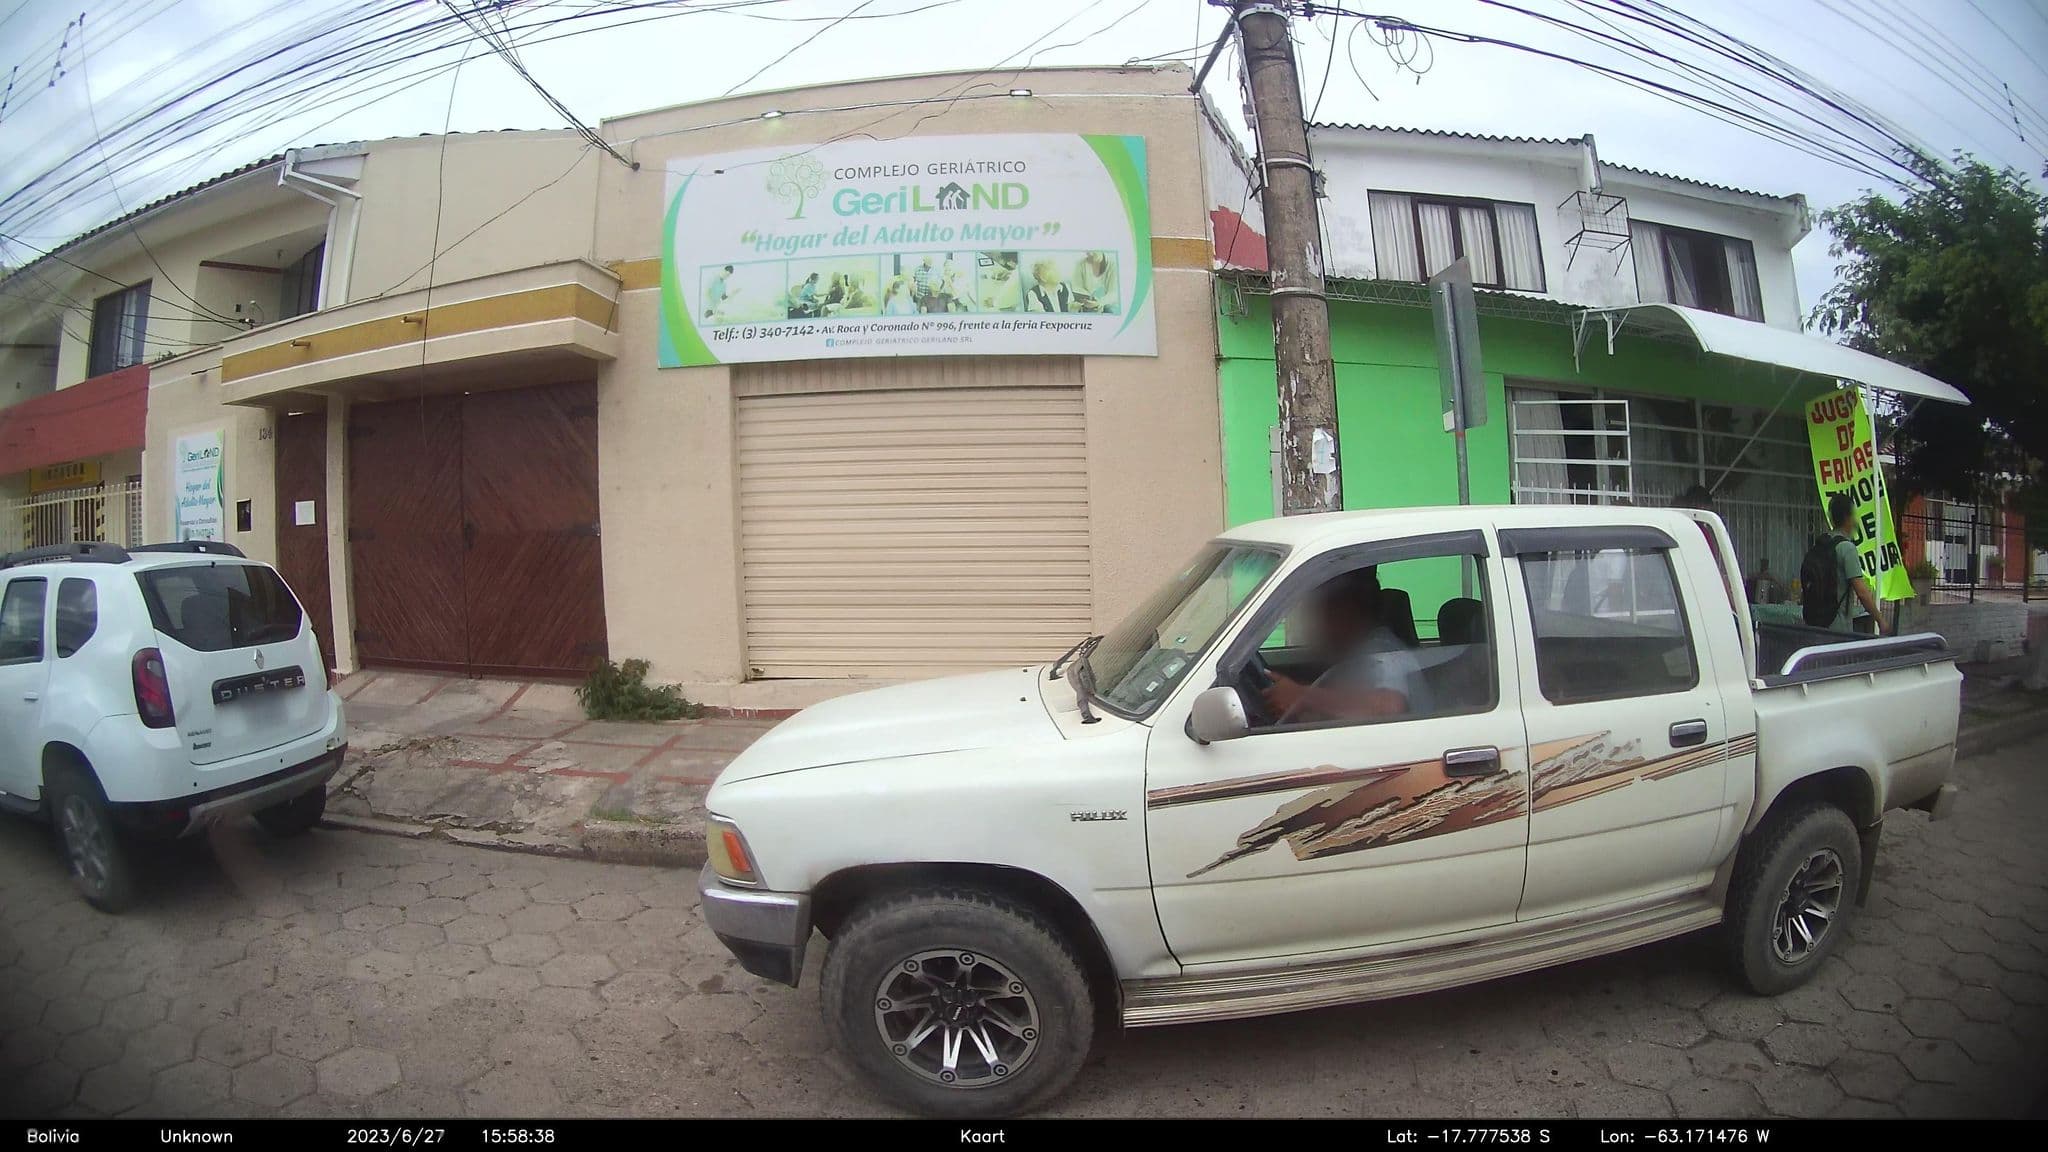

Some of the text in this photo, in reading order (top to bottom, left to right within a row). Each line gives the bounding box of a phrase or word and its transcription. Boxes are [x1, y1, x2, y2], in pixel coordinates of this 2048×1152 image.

[834, 159, 1027, 180] COMPLEJO GERIÁTRICO
[833, 223, 868, 247] del
[873, 222, 955, 245] Adulto
[713, 329, 739, 343] Telf.:
[742, 326, 757, 341] (3)
[760, 325, 815, 340] 340-7142
[837, 323, 860, 334] Roca
[863, 324, 869, 335] y
[871, 320, 919, 333] Coronado
[937, 321, 957, 332] 996,
[959, 320, 991, 332] frente
[992, 322, 1000, 331] a
[1001, 319, 1012, 331] la
[1012, 319, 1038, 332] feria
[1039, 319, 1093, 332] Fexpocruz
